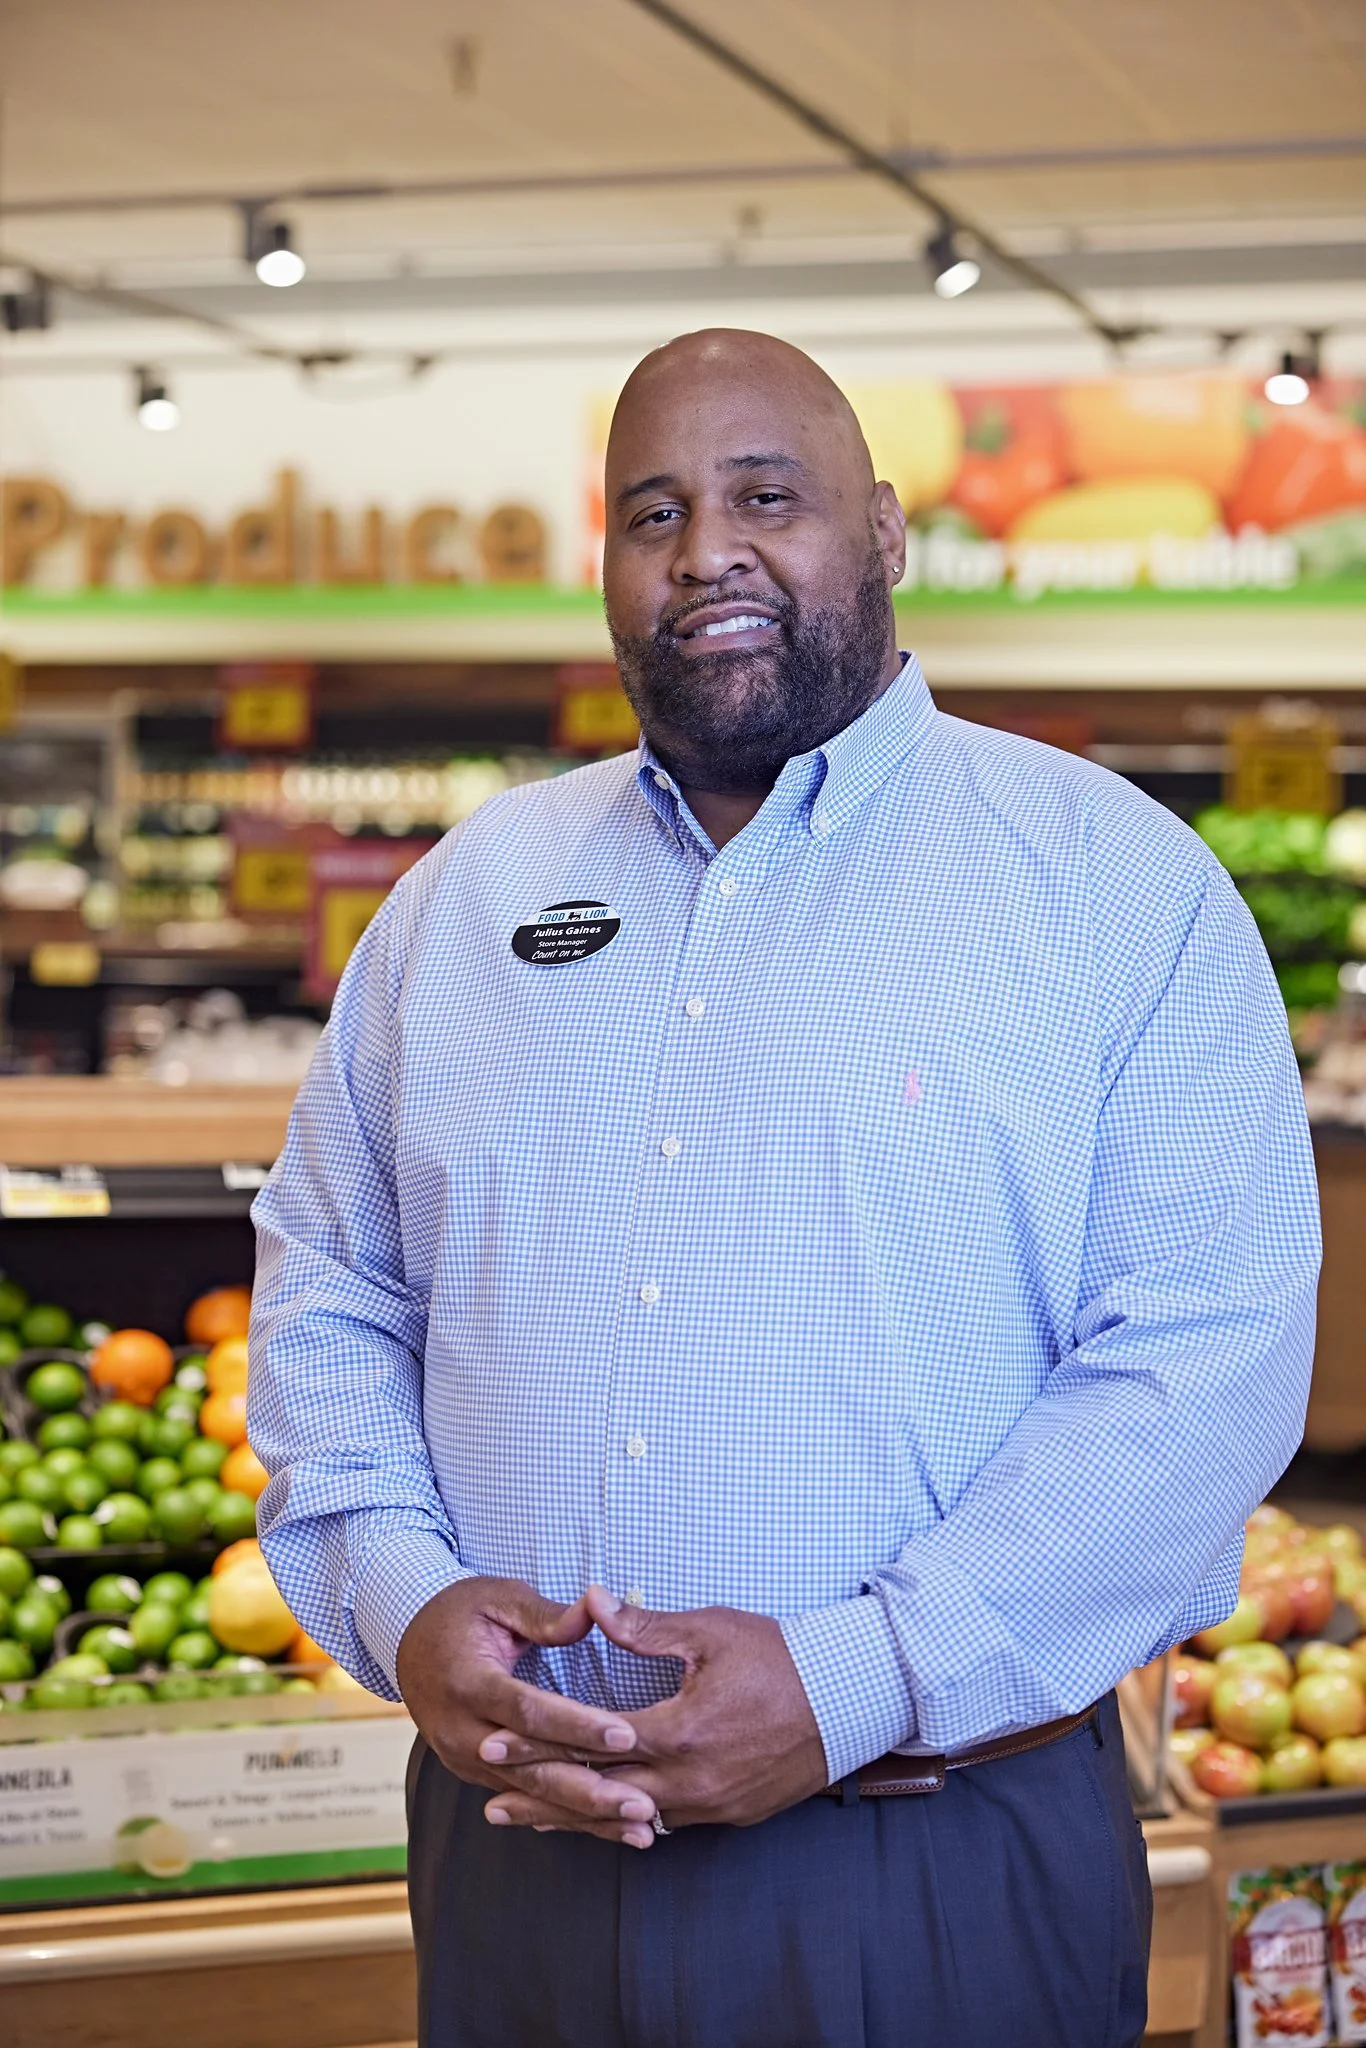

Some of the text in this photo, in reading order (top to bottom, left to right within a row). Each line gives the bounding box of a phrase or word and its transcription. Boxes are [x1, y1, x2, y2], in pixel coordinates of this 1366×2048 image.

[0, 467, 548, 587] Produce
[538, 909, 608, 923] FOOD LION
[533, 926, 601, 938] Julius Gaines
[557, 939, 587, 948] Manager
[532, 950, 558, 960] Count
[572, 949, 586, 957] me
